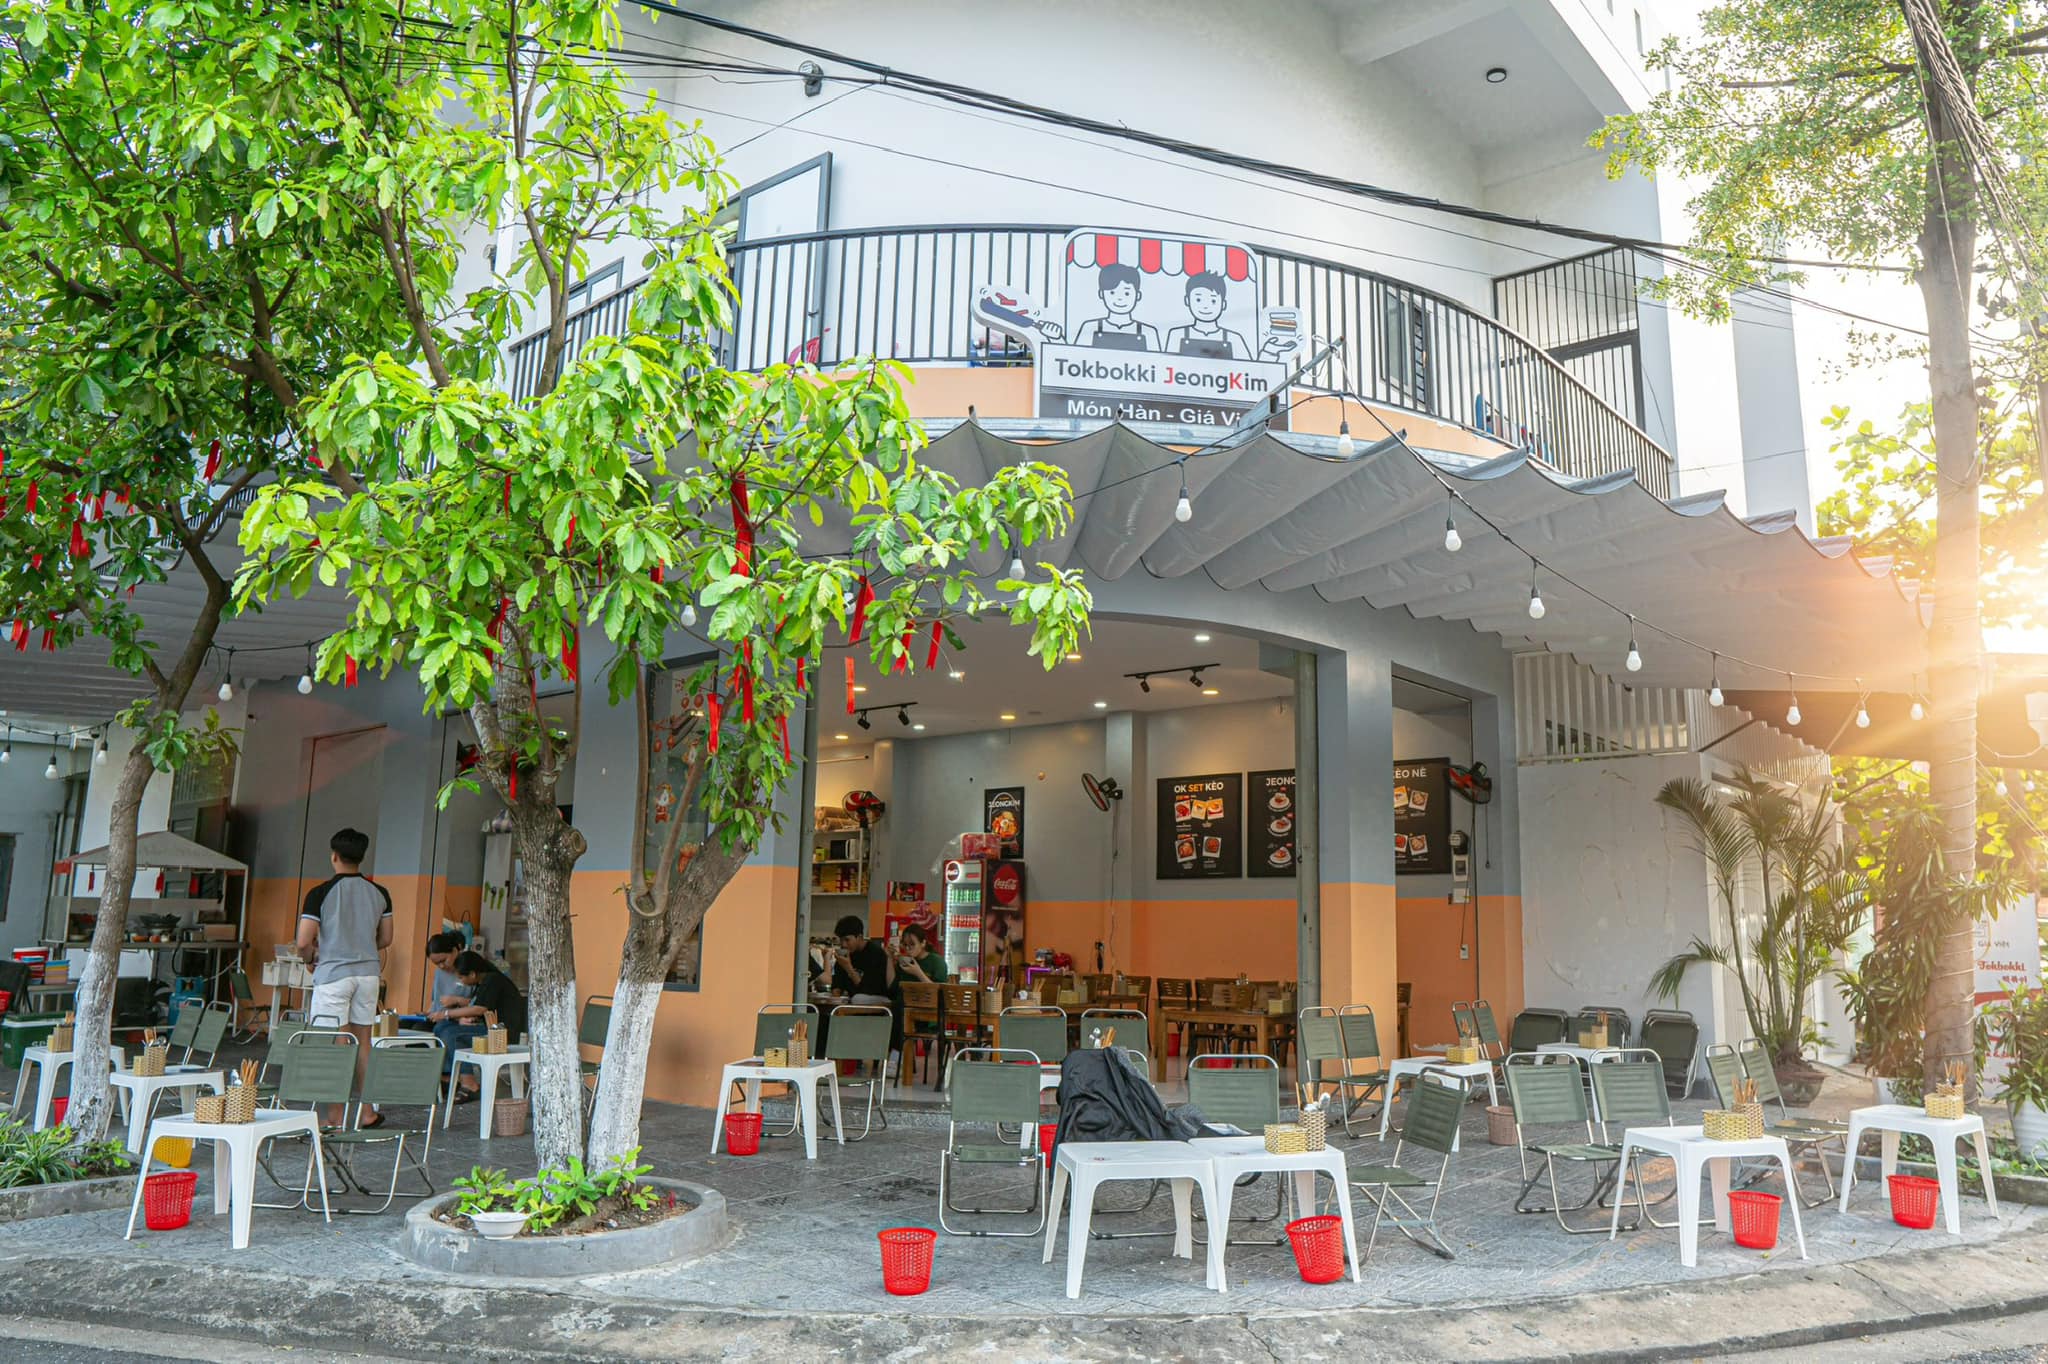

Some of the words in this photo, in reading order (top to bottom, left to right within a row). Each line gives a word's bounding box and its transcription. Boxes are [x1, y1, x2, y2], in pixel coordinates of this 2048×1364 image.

[1055, 358, 1156, 384] Tokbokki
[1163, 367, 1268, 393] JeongKim
[1067, 399, 1111, 417] Món
[1121, 402, 1161, 421] Hàn
[1179, 406, 1216, 426] Giá
[1174, 784, 1187, 793] OK
[1188, 783, 1204, 793] SET
